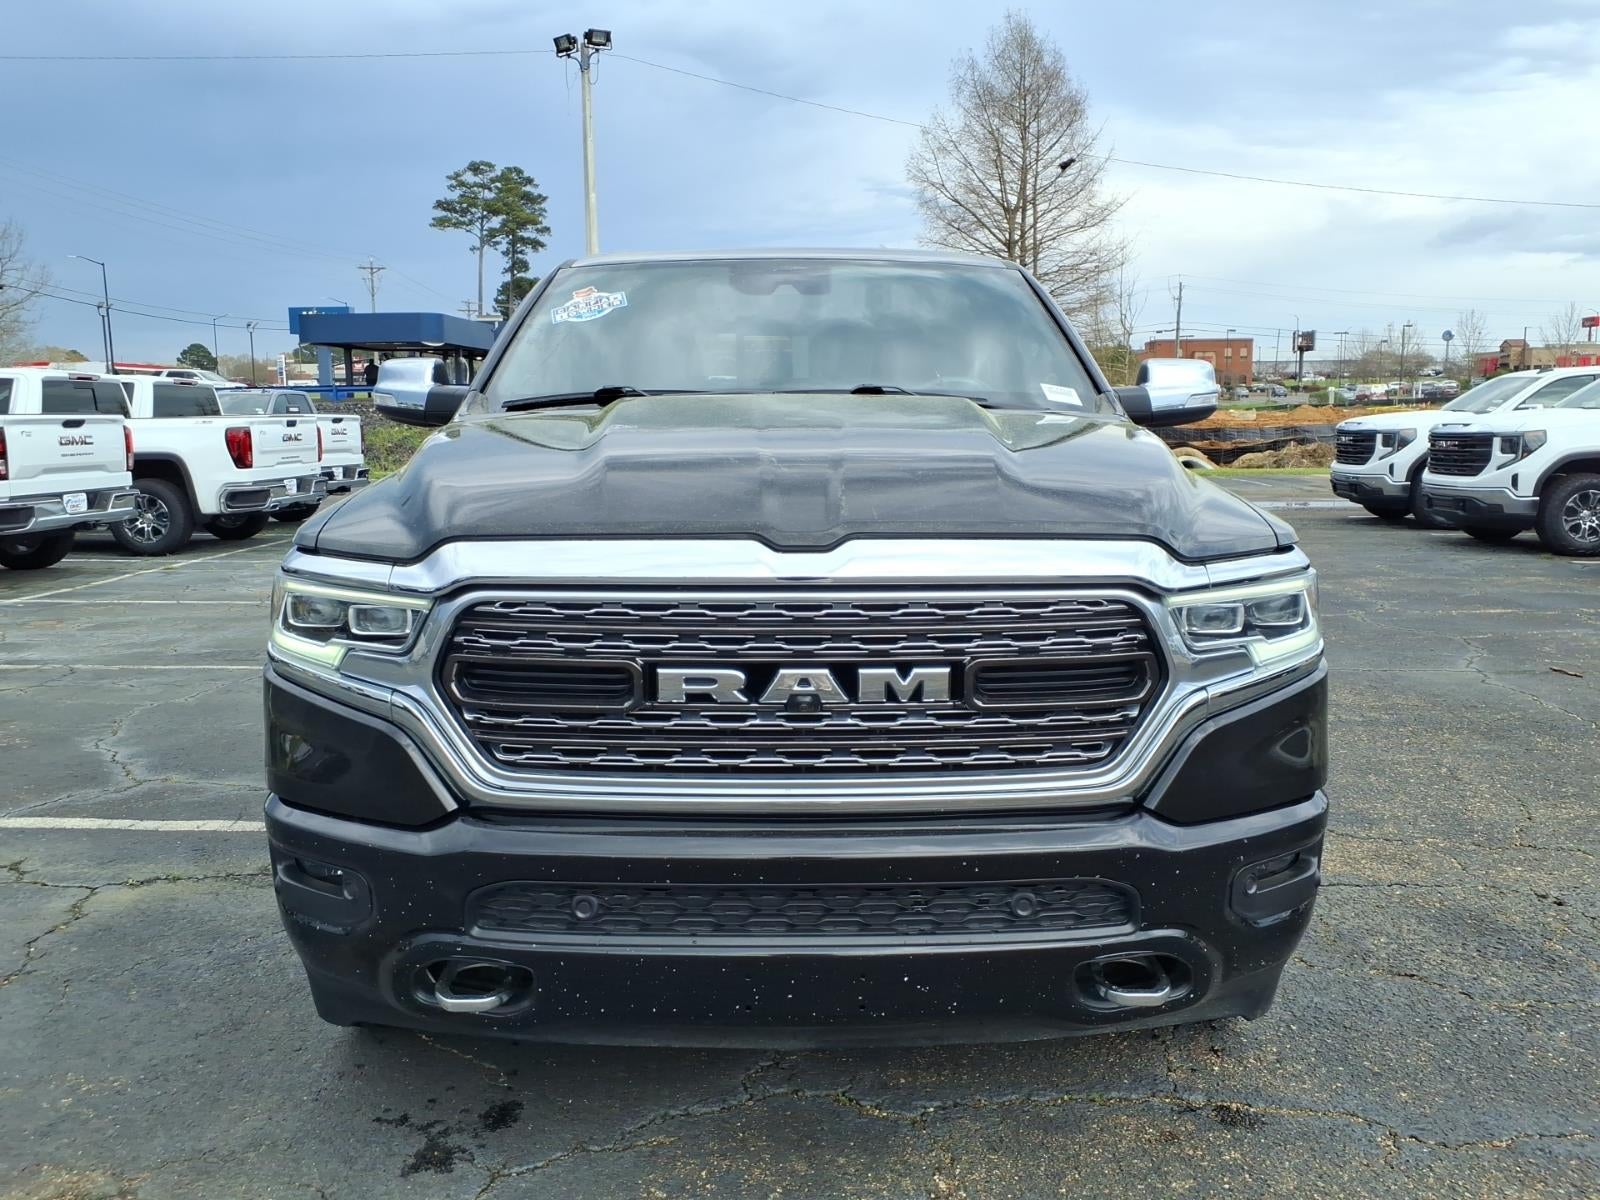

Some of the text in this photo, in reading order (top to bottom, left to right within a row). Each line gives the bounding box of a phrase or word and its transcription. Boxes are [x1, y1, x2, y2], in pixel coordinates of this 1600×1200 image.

[331, 428, 347, 436] GMC
[59, 435, 94, 446] GMC
[282, 433, 302, 442] GMC
[656, 667, 950, 703] RAM
